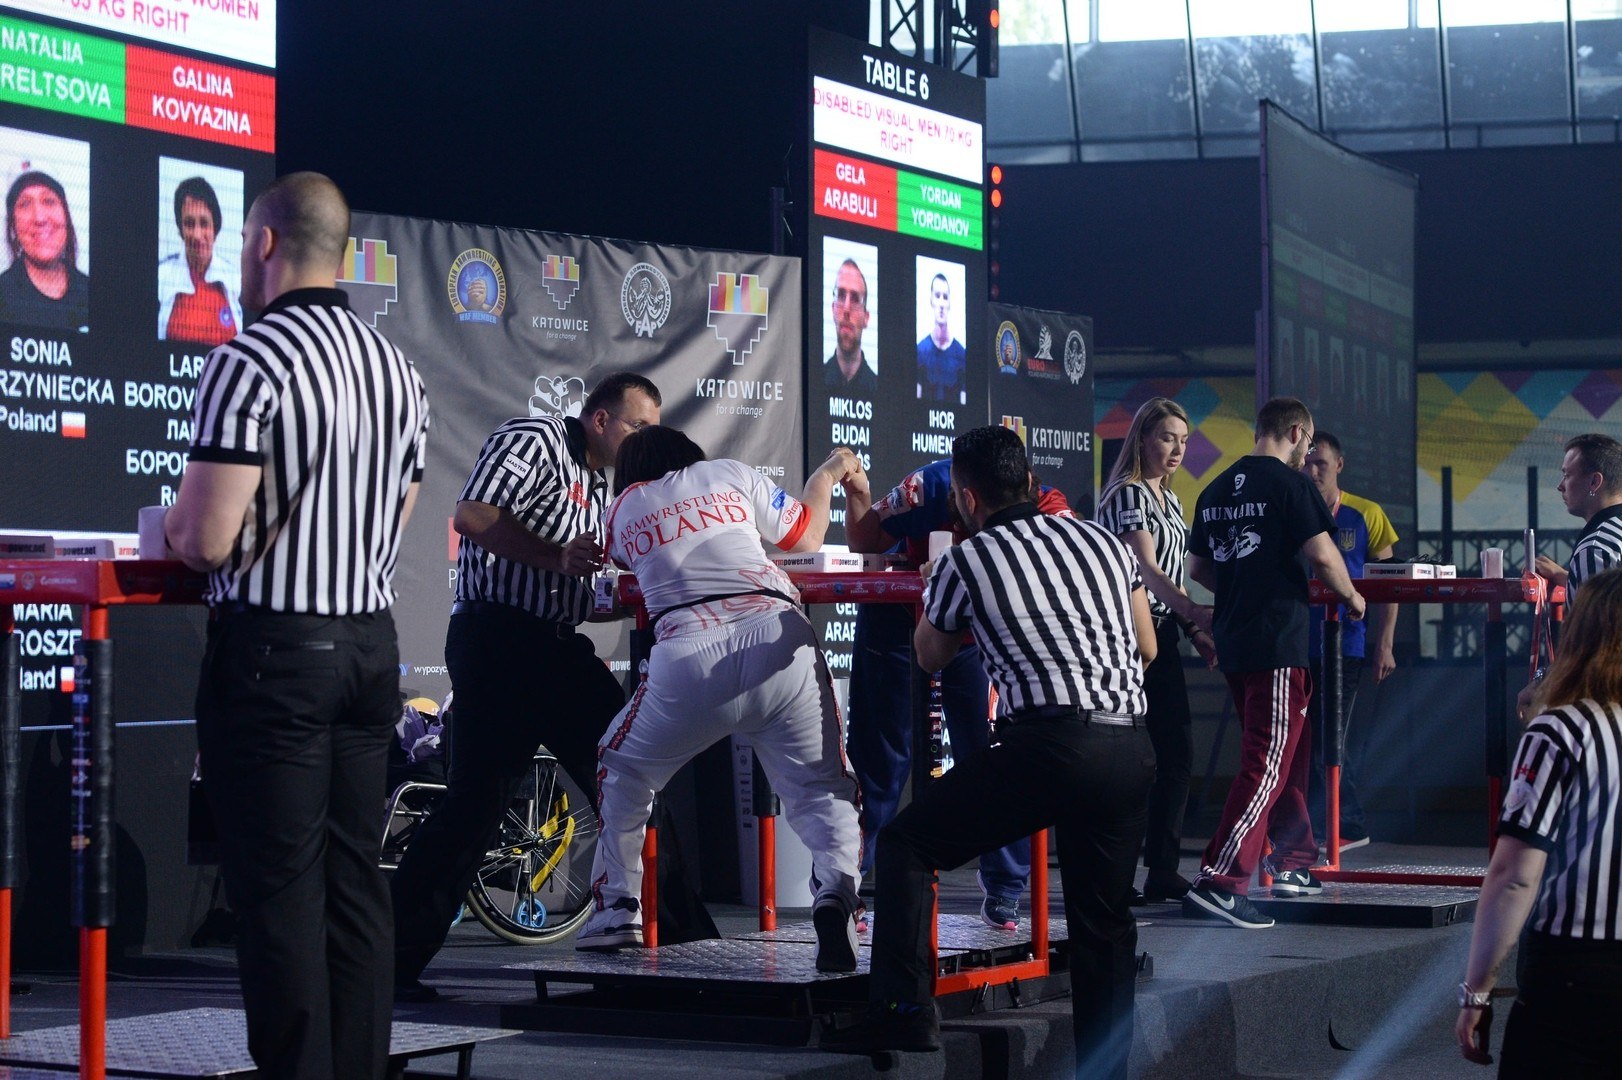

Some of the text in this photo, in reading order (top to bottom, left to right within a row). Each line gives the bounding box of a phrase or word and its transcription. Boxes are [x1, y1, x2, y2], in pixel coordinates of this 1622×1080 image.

[133, 2, 190, 33] RIGHT
[1, 26, 84, 65] NATALIIA
[0, 62, 111, 109] RELTSOVA
[172, 65, 234, 98] GALINA
[862, 54, 930, 101] TABLE 6
[152, 94, 252, 136] KOVYAZINA
[813, 87, 872, 120] DISABLED
[876, 105, 915, 132] VISUAL
[918, 118, 941, 139] MEN
[880, 130, 914, 155] RIGHT
[835, 162, 866, 186] GELA
[824, 186, 877, 218] ARABULI
[920, 183, 962, 210] YORDAN
[911, 207, 970, 238] YORDANOV
[532, 316, 589, 332] KATOWICE
[10, 336, 72, 366] SONIA
[0, 368, 115, 405] RZYNIECKA
[696, 378, 784, 400] KATOWICE
[0, 405, 57, 433] Poland
[716, 403, 730, 416] for
[736, 404, 763, 418] change
[829, 396, 873, 421] MIKLOS
[929, 409, 955, 430] IHOR
[832, 422, 870, 447] BUDAI
[912, 432, 956, 455] HUMEN
[1032, 427, 1090, 452] KATOWICE
[506, 458, 527, 473] MASTER
[1044, 454, 1064, 469] change
[619, 490, 741, 544] ARMWRESTLING
[1202, 502, 1267, 523] HUNGARY
[624, 504, 747, 562] POLAND
[413, 666, 448, 676] wypozyc
